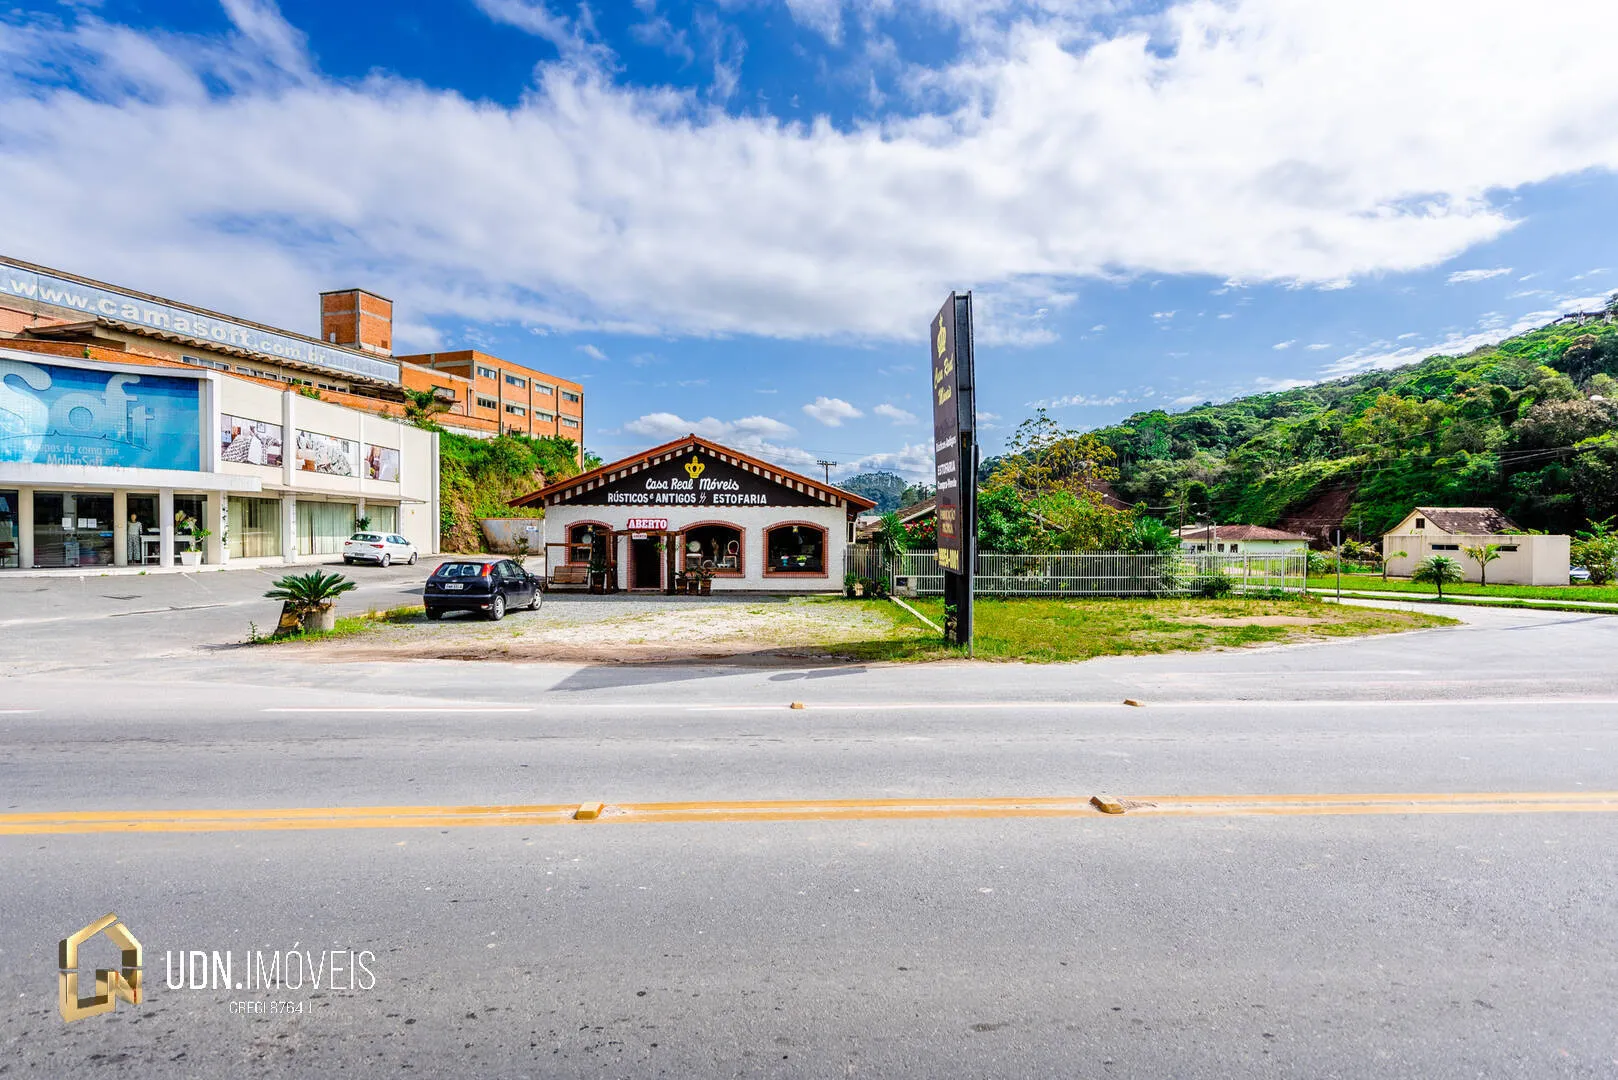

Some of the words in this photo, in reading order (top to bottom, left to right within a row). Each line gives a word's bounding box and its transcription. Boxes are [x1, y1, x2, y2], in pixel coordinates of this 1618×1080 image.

[645, 478, 669, 490] Casa
[671, 478, 694, 490] Real
[699, 478, 740, 491] Móveis
[607, 491, 648, 503] RÚSTICOS
[655, 492, 696, 503] ANTIGOS
[713, 493, 768, 504] ESTOFARIA
[628, 519, 667, 529] ABERTO
